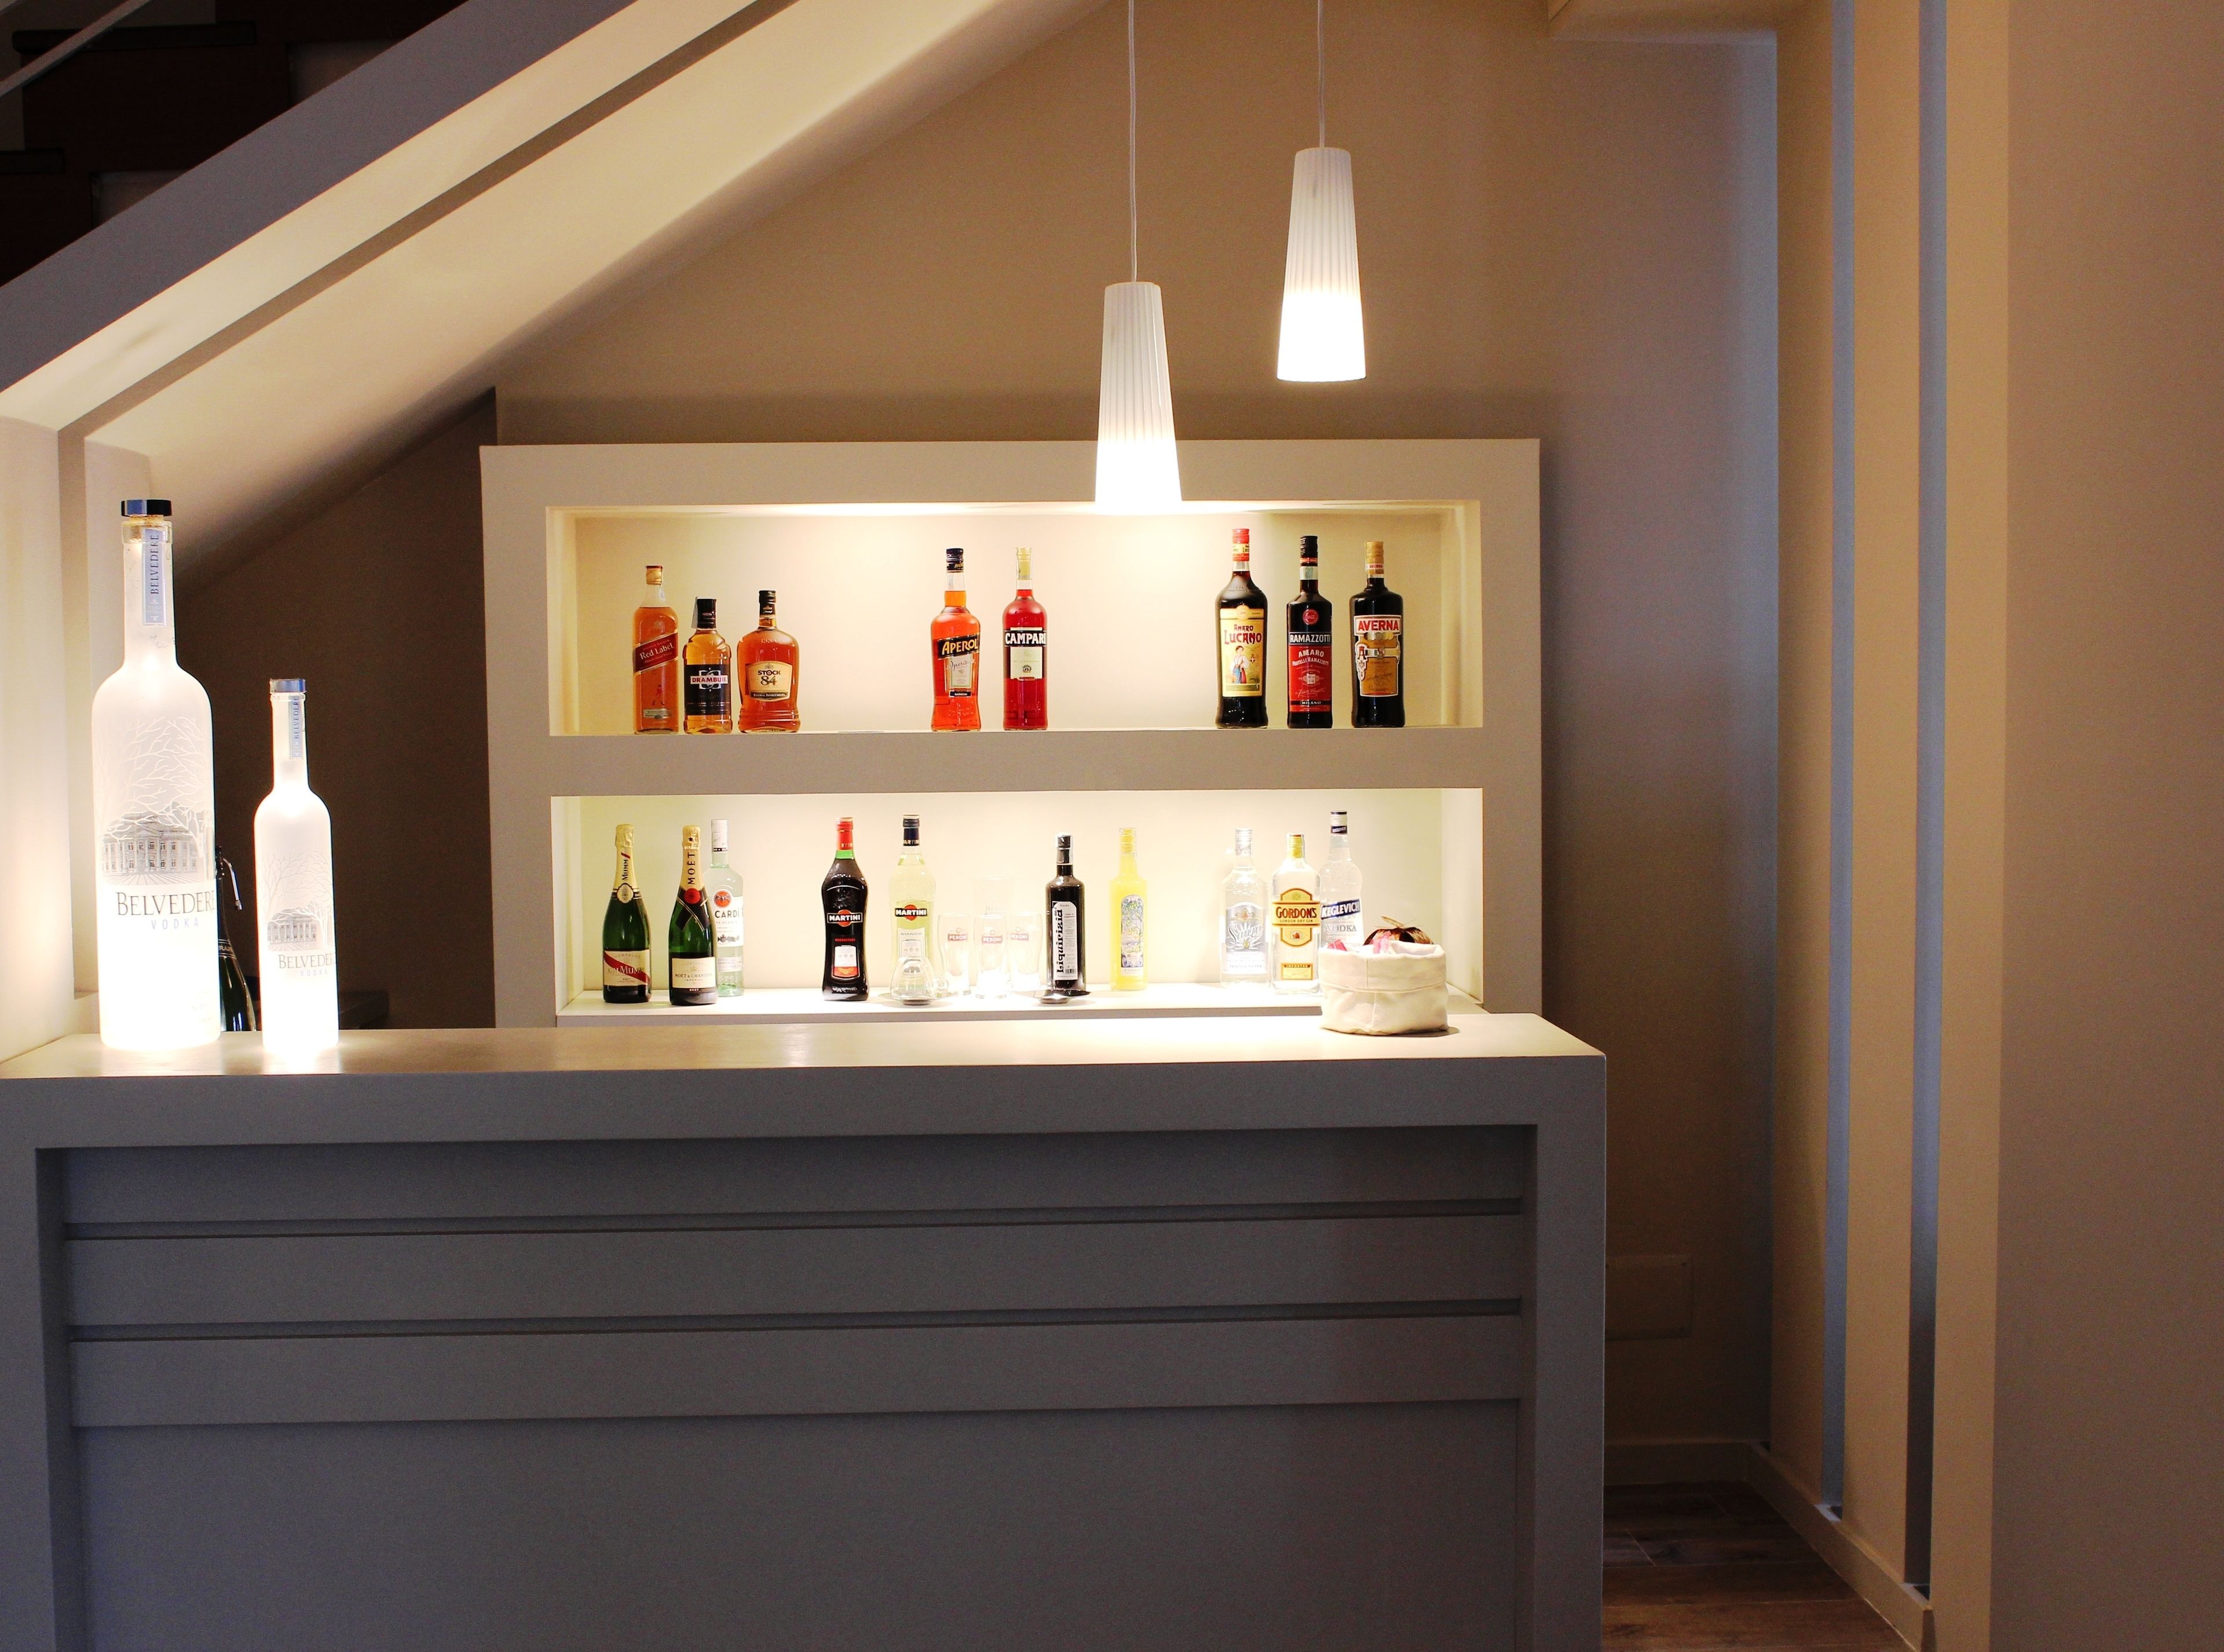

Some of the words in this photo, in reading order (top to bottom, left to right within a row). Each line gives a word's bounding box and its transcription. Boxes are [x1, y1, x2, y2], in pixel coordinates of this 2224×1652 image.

[150, 535, 159, 595] BELVEDERE
[1358, 620, 1399, 631] AVERNA
[1005, 633, 1046, 645] CAMPARI
[1224, 630, 1262, 644] LUCANO
[1290, 634, 1331, 643] RAMAZZOTTI
[639, 649, 654, 660] Red
[654, 642, 673, 655] Label
[942, 638, 978, 655] APEROL
[1298, 649, 1325, 658] AMARO
[760, 675, 777, 686] 84
[1275, 907, 1317, 919] GORDON'S
[1321, 900, 1360, 918] KEGLEVICH
[151, 917, 199, 930] VODKA
[829, 913, 861, 922] MARTINI
[1325, 924, 1357, 932] VODKA
[1056, 909, 1066, 973] Liquirizia
